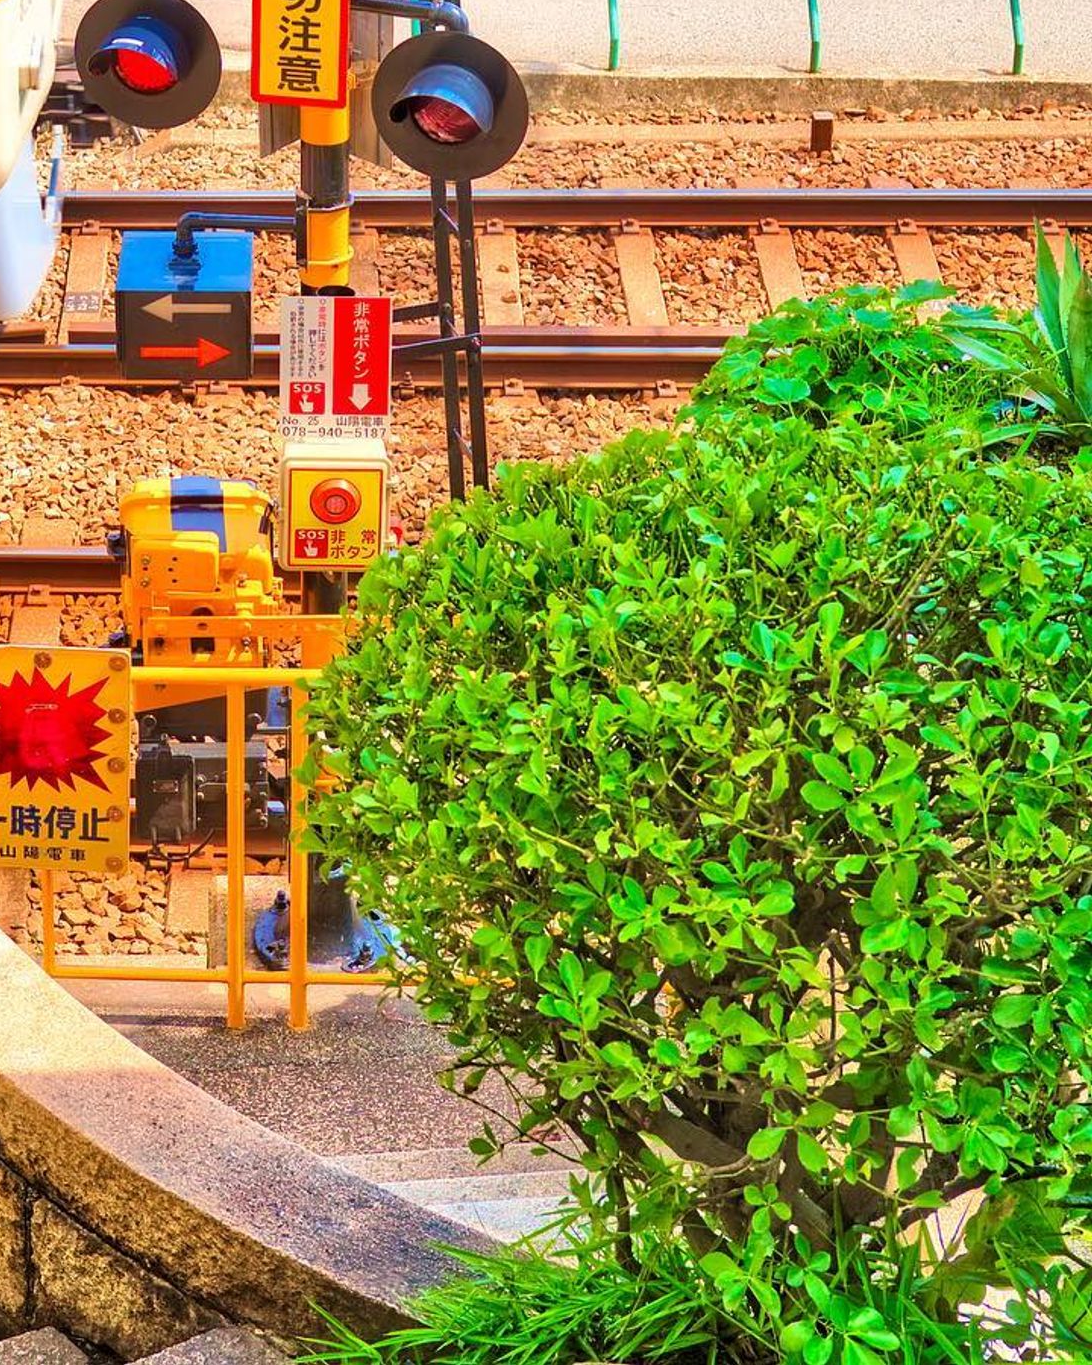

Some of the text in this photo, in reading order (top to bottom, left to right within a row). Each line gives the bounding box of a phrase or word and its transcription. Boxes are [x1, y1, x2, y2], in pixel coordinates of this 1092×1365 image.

[353, 301, 371, 379] 非常ボタン
[293, 384, 323, 393] SOS
[307, 416, 320, 426] 25
[336, 417, 384, 426] 山陽電車
[297, 530, 326, 540] SOS
[330, 546, 376, 559] ボタン
[0, 845, 86, 861] 山陽電車
